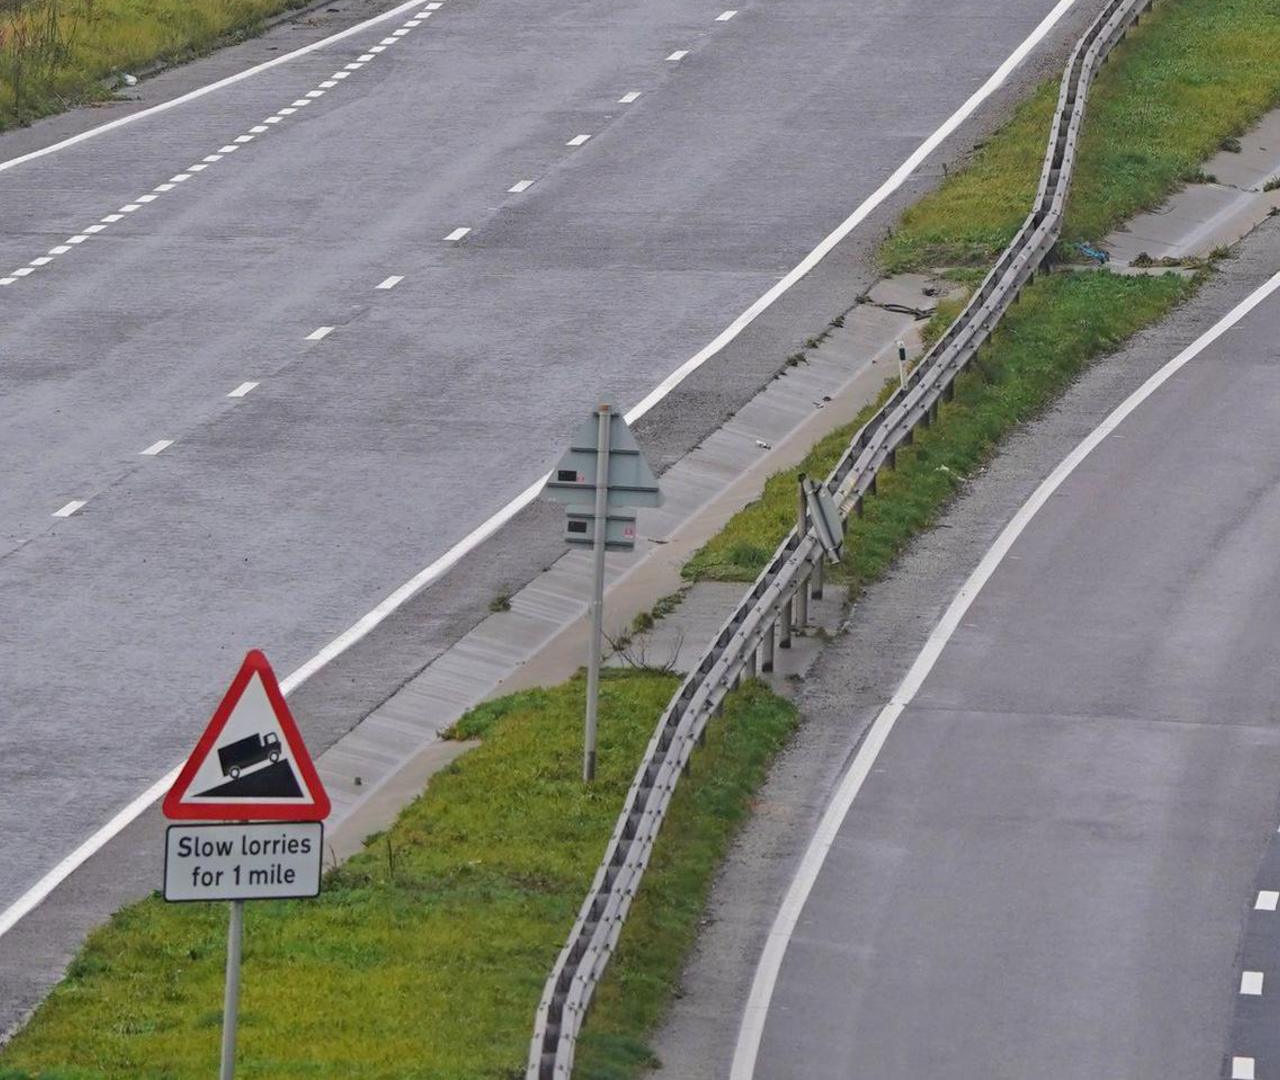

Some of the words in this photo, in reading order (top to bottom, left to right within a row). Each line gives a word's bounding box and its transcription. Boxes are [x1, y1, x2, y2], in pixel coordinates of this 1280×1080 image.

[177, 836, 233, 857] Slow
[241, 834, 311, 856] lorries
[192, 866, 223, 887] for
[233, 865, 241, 886] 1
[248, 863, 296, 885] mile
